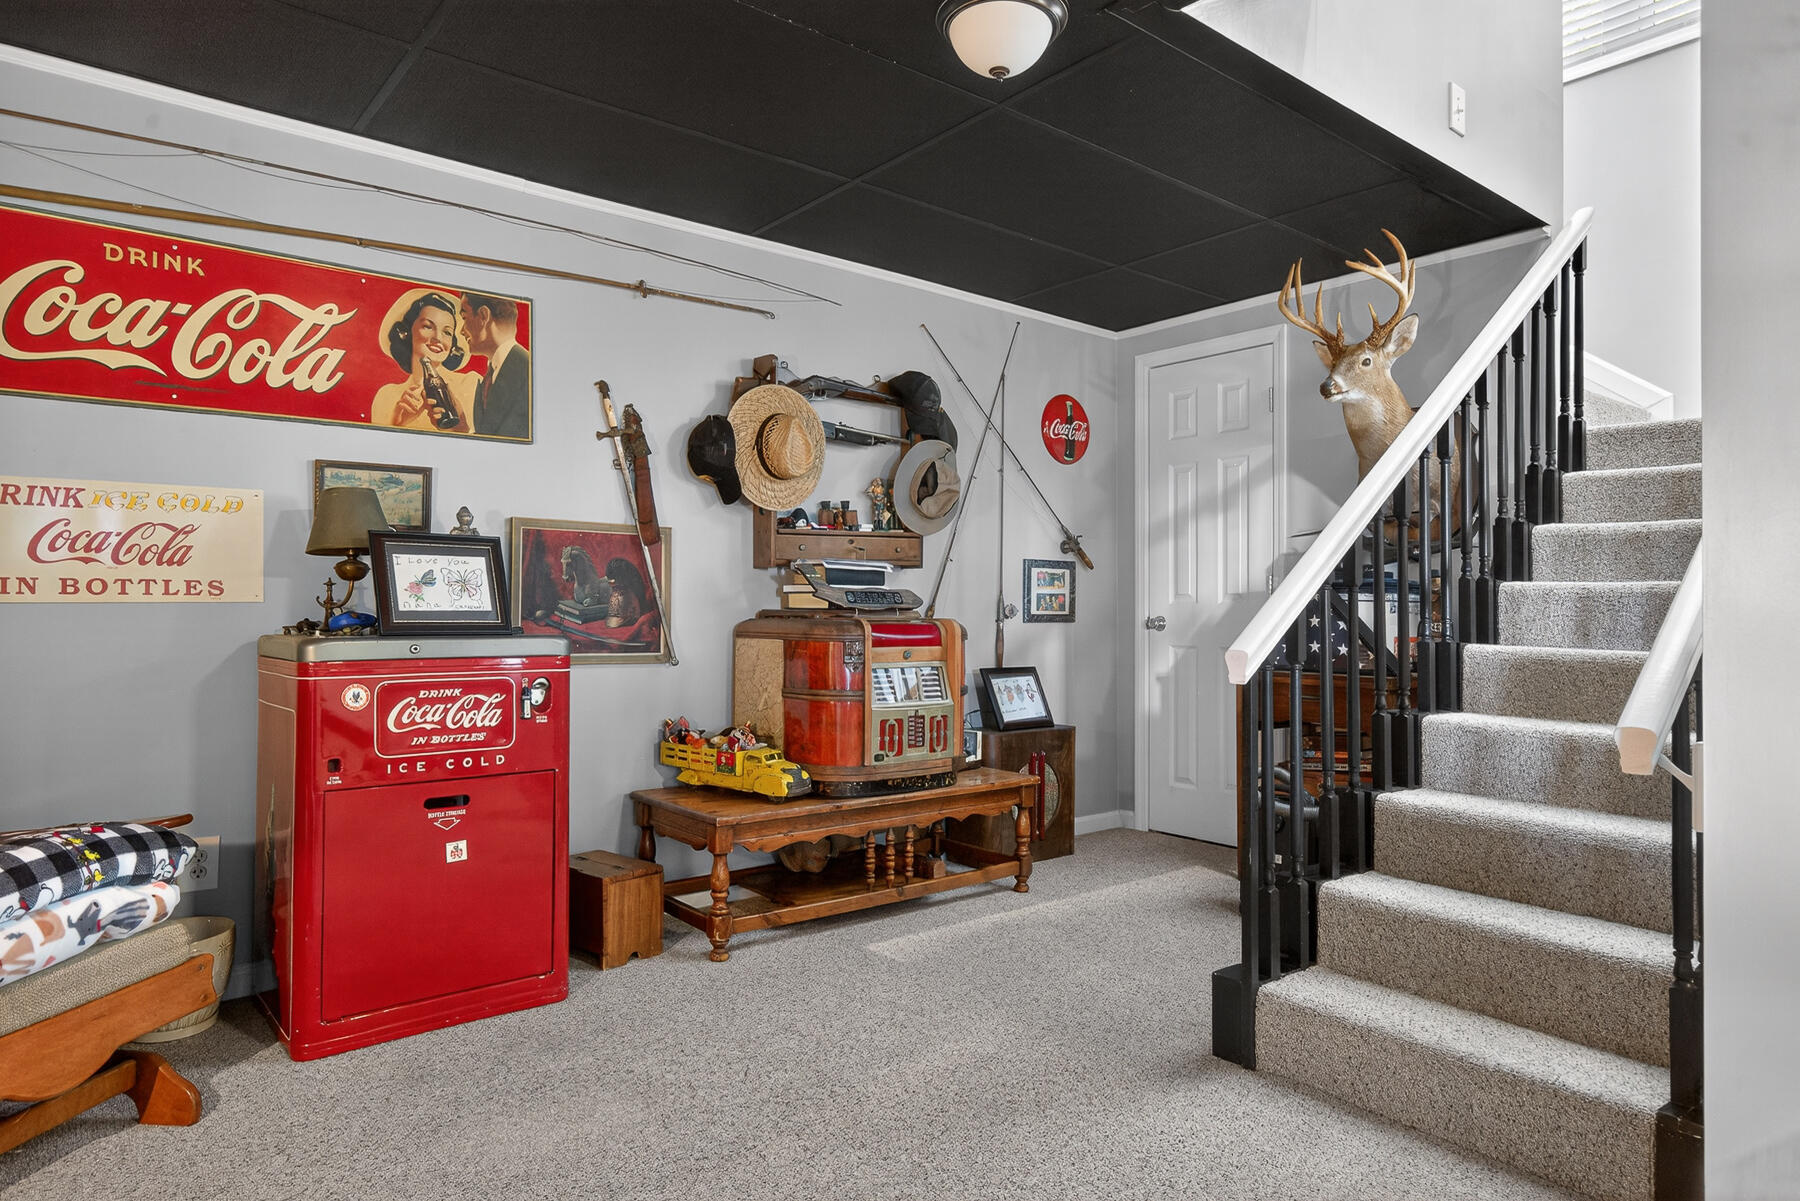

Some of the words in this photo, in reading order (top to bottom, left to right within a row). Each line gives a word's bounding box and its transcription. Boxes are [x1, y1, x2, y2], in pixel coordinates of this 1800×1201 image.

[103, 242, 206, 277] DRINK
[0, 259, 358, 394] Coca-Cola
[88, 490, 150, 512] ICE
[157, 492, 244, 514] COLD
[27, 518, 202, 567] Coca-Cola
[0, 577, 39, 595] IN
[58, 578, 225, 597] BOTTLES
[418, 688, 463, 699] DRINK
[387, 693, 506, 733] Coca-Cola
[411, 736, 428, 746] IN
[430, 732, 487, 745] BOTTLES
[387, 761, 426, 774] ICE
[446, 754, 505, 769] COLD
